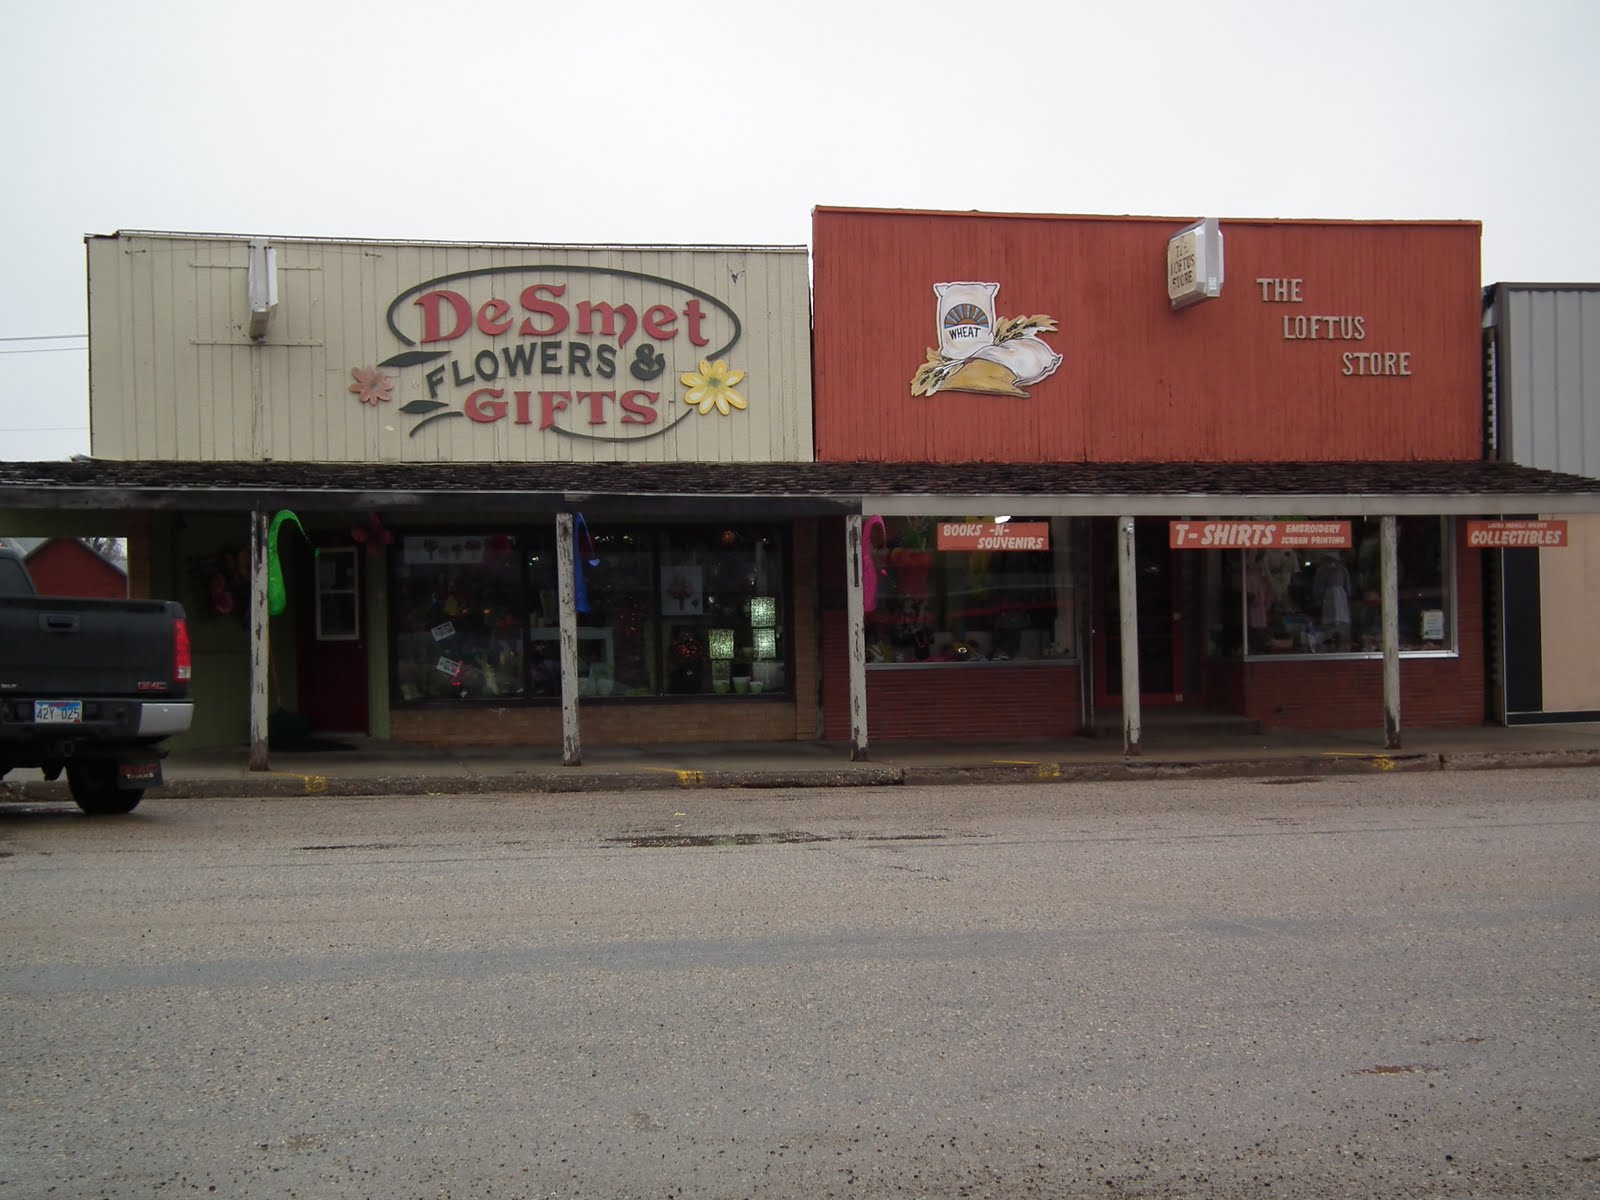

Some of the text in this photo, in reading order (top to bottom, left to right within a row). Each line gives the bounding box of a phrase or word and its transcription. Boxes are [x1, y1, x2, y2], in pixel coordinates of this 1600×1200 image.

[1256, 277, 1303, 302] THE
[414, 283, 710, 349] DeSmet
[948, 326, 982, 340] WHEAT
[1282, 315, 1365, 340] LOFTUS
[425, 341, 666, 399] FLOWERS &
[1342, 352, 1412, 376] STORE
[464, 388, 660, 430] GIFTS
[943, 524, 983, 536] BOOKS
[1285, 523, 1341, 534] EMBROIDERY
[977, 536, 1044, 549] SOUVENIRS
[1281, 536, 1345, 545] SCREEN PRINTING
[1471, 530, 1562, 545] COLLECTIBLES
[137, 681, 168, 691] GMC
[36, 707, 81, 720] 42Y 025
